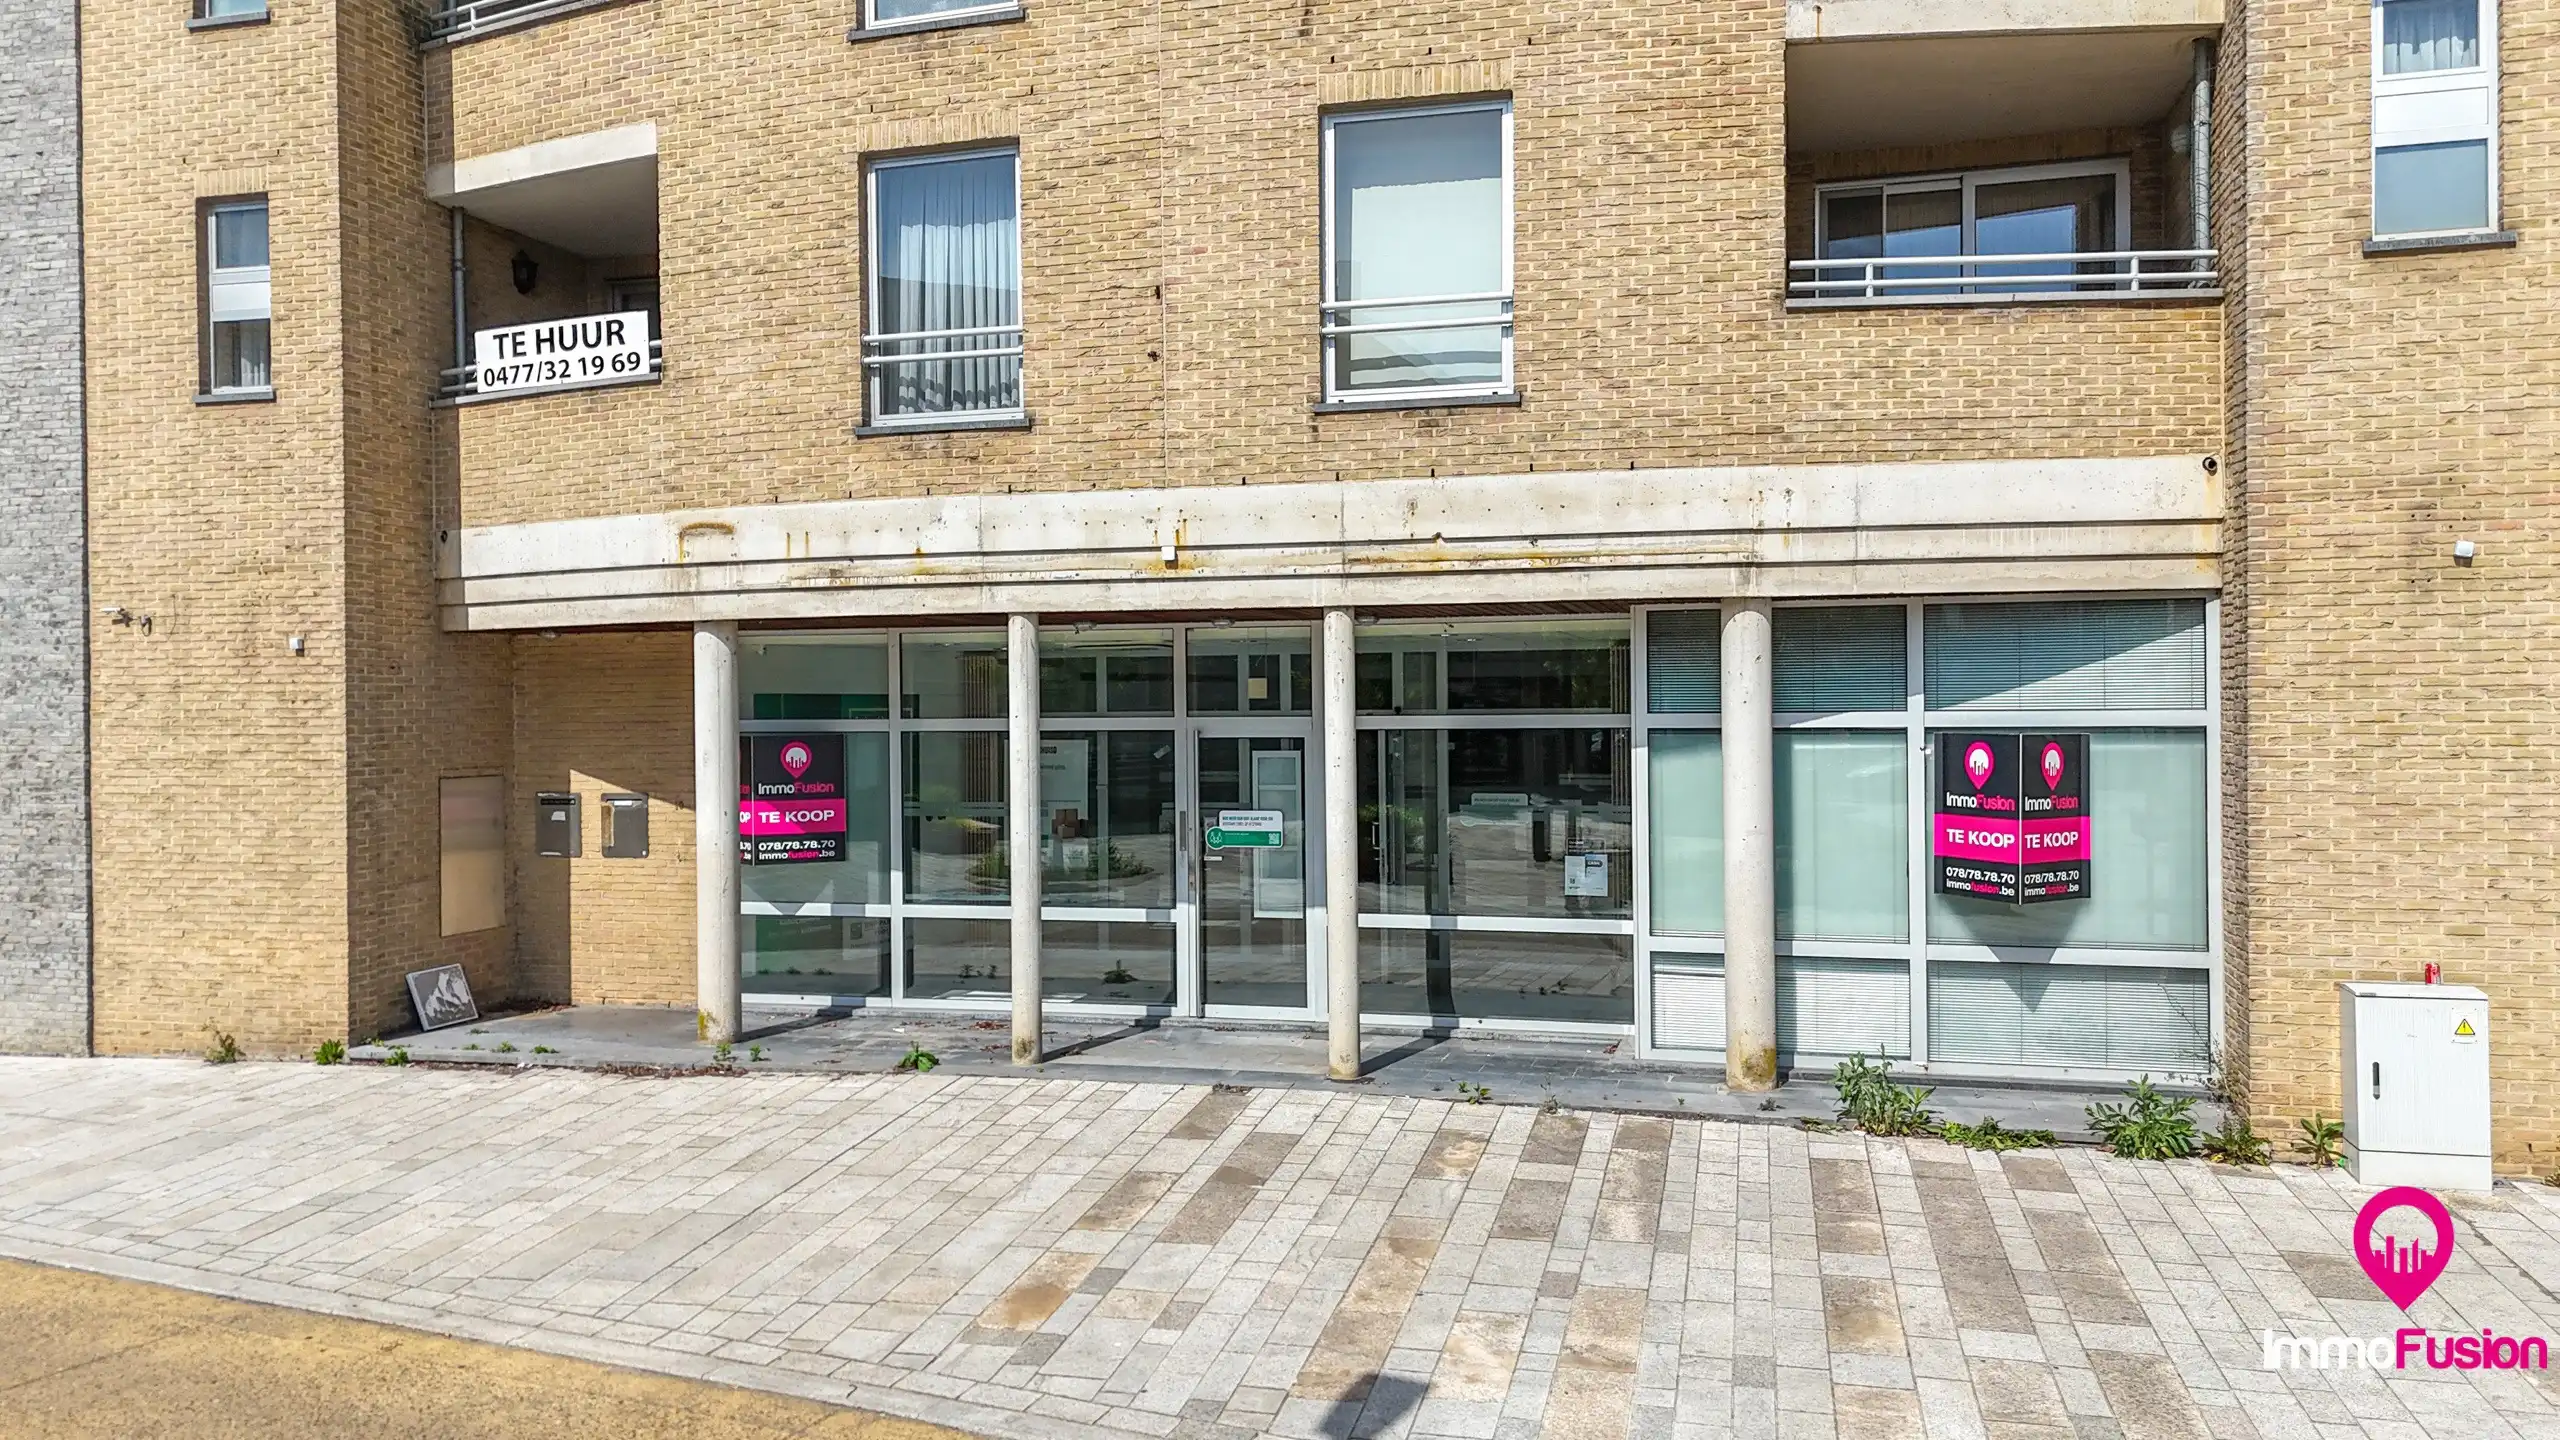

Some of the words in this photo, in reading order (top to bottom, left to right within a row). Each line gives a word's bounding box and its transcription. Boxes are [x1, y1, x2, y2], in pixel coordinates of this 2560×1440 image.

[492, 330, 527, 359] TE
[535, 319, 626, 355] HUUR
[483, 359, 571, 387] 0477/32
[578, 356, 604, 376] 19
[611, 351, 641, 373] 69
[758, 782, 834, 795] ImmoFusion
[1946, 792, 2015, 811] ImmoFusion
[2024, 796, 2078, 811] ImmoFusion
[758, 811, 780, 823] TE
[785, 810, 835, 823] KOOP
[758, 840, 836, 851] 078/78.78.70
[1946, 828, 1964, 844] TE
[1968, 830, 2015, 848] KOOP
[2024, 833, 2041, 849] TE
[2043, 831, 2078, 847] KOOP
[758, 850, 835, 860] immofusion.be
[1945, 866, 2015, 884] 078/78.78.70
[2024, 870, 2079, 885] 078/78.78.70
[1946, 879, 2015, 896] immofusion.be
[2024, 883, 2079, 896] immofusion.be
